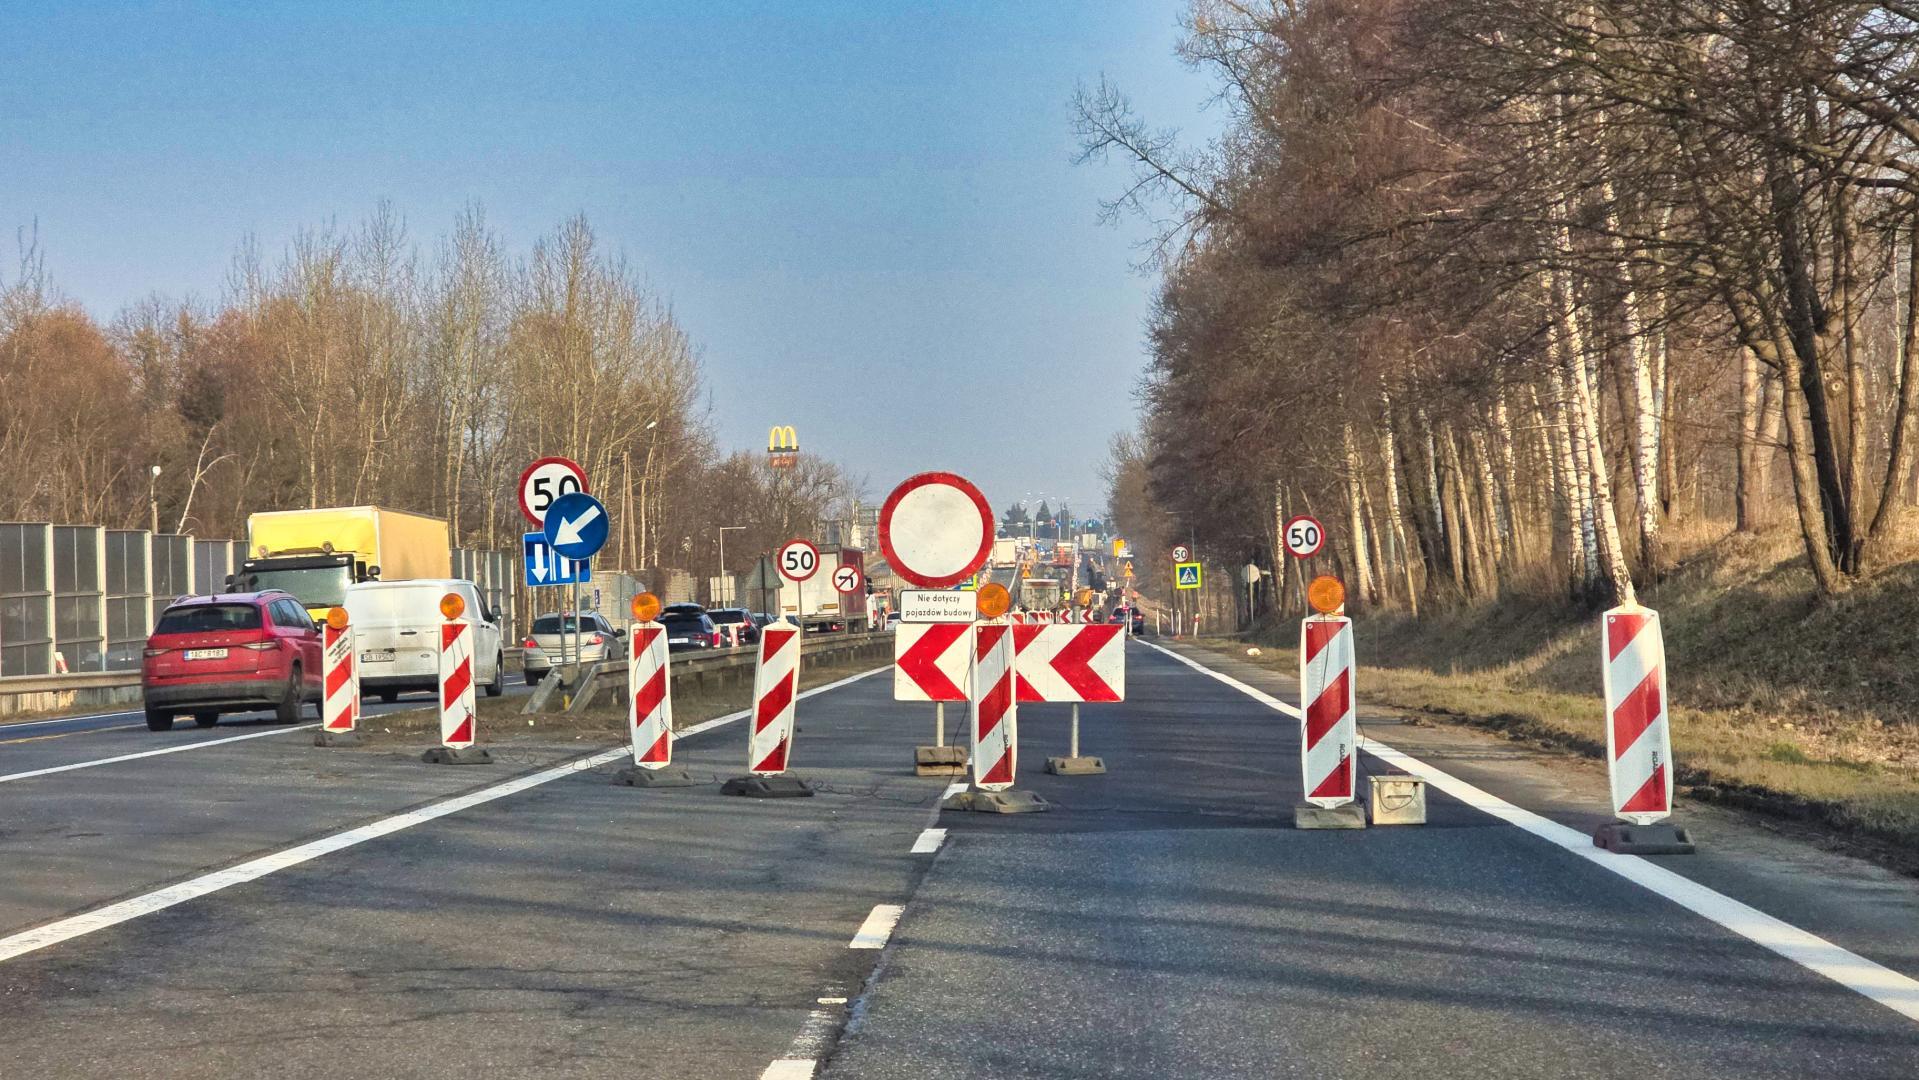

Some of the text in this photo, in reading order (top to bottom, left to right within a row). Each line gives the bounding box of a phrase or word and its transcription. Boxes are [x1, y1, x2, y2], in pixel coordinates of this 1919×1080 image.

[533, 474, 581, 512] 50
[1291, 527, 1318, 548] 50
[785, 550, 814, 571] 50
[1173, 549, 1188, 560] 50
[917, 594, 961, 605] Nie dotyczy
[906, 607, 972, 619] pojazdów budowy
